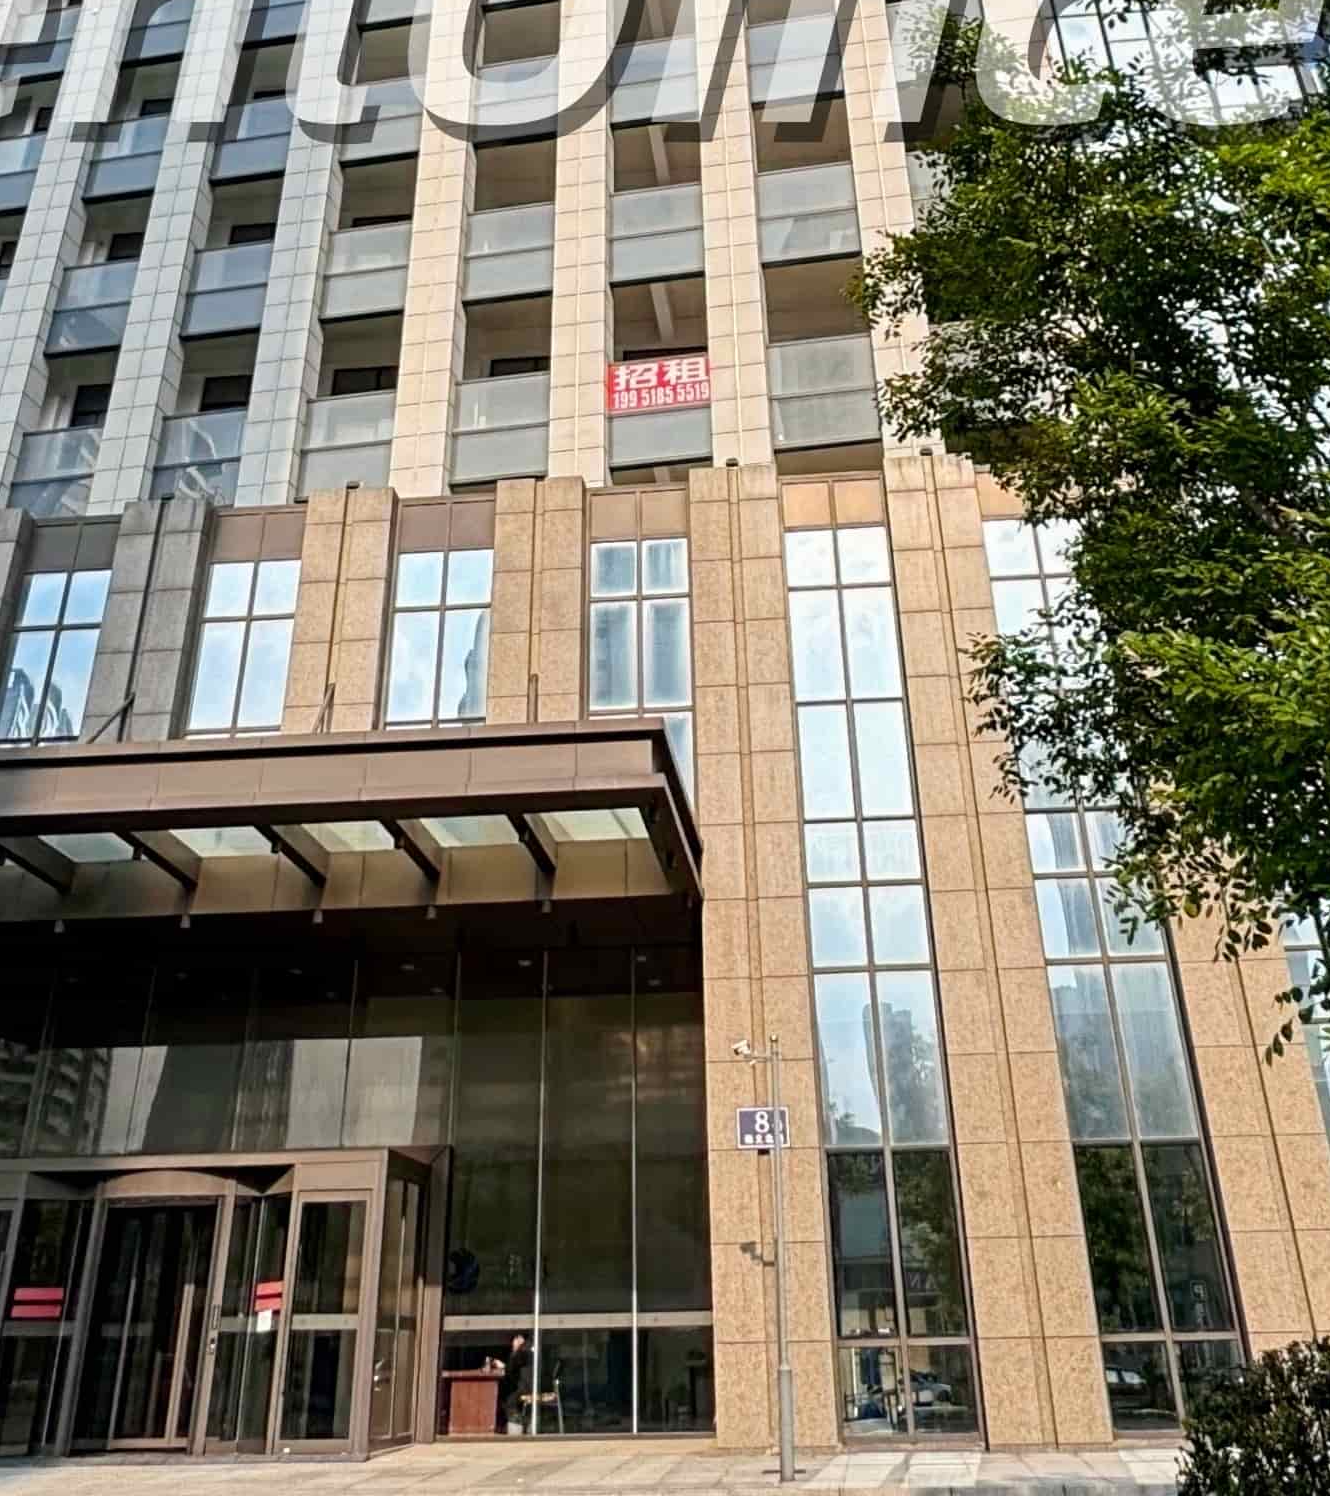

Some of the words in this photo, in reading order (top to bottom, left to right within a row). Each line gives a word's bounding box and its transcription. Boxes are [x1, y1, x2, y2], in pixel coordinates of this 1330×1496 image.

[613, 357, 709, 391] 招租
[614, 391, 638, 409] 199
[676, 381, 709, 402] 5519
